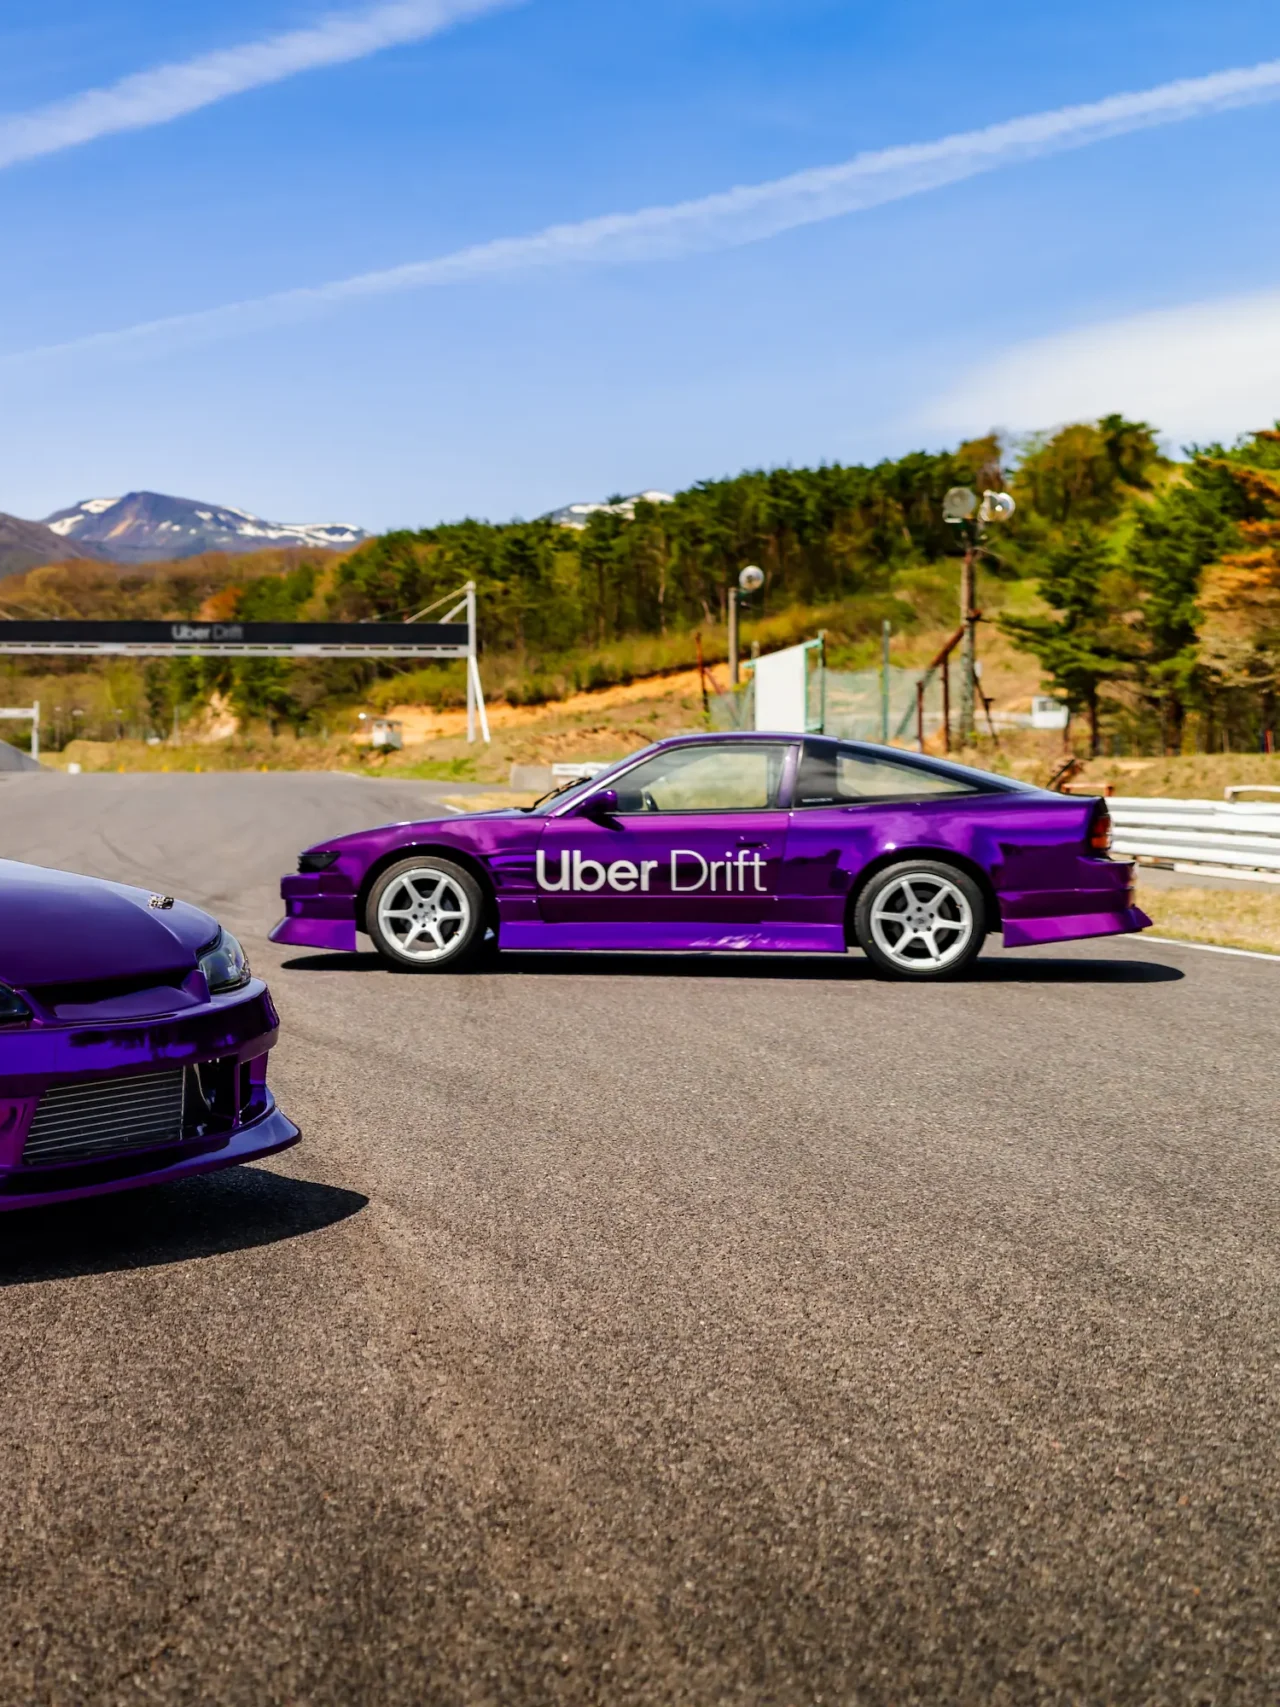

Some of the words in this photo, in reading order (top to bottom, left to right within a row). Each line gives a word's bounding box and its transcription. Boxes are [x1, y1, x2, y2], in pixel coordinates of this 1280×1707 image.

[171, 624, 211, 640] Uber
[212, 624, 244, 640] Drift
[535, 849, 659, 892] Uber
[670, 849, 768, 892] Drift
